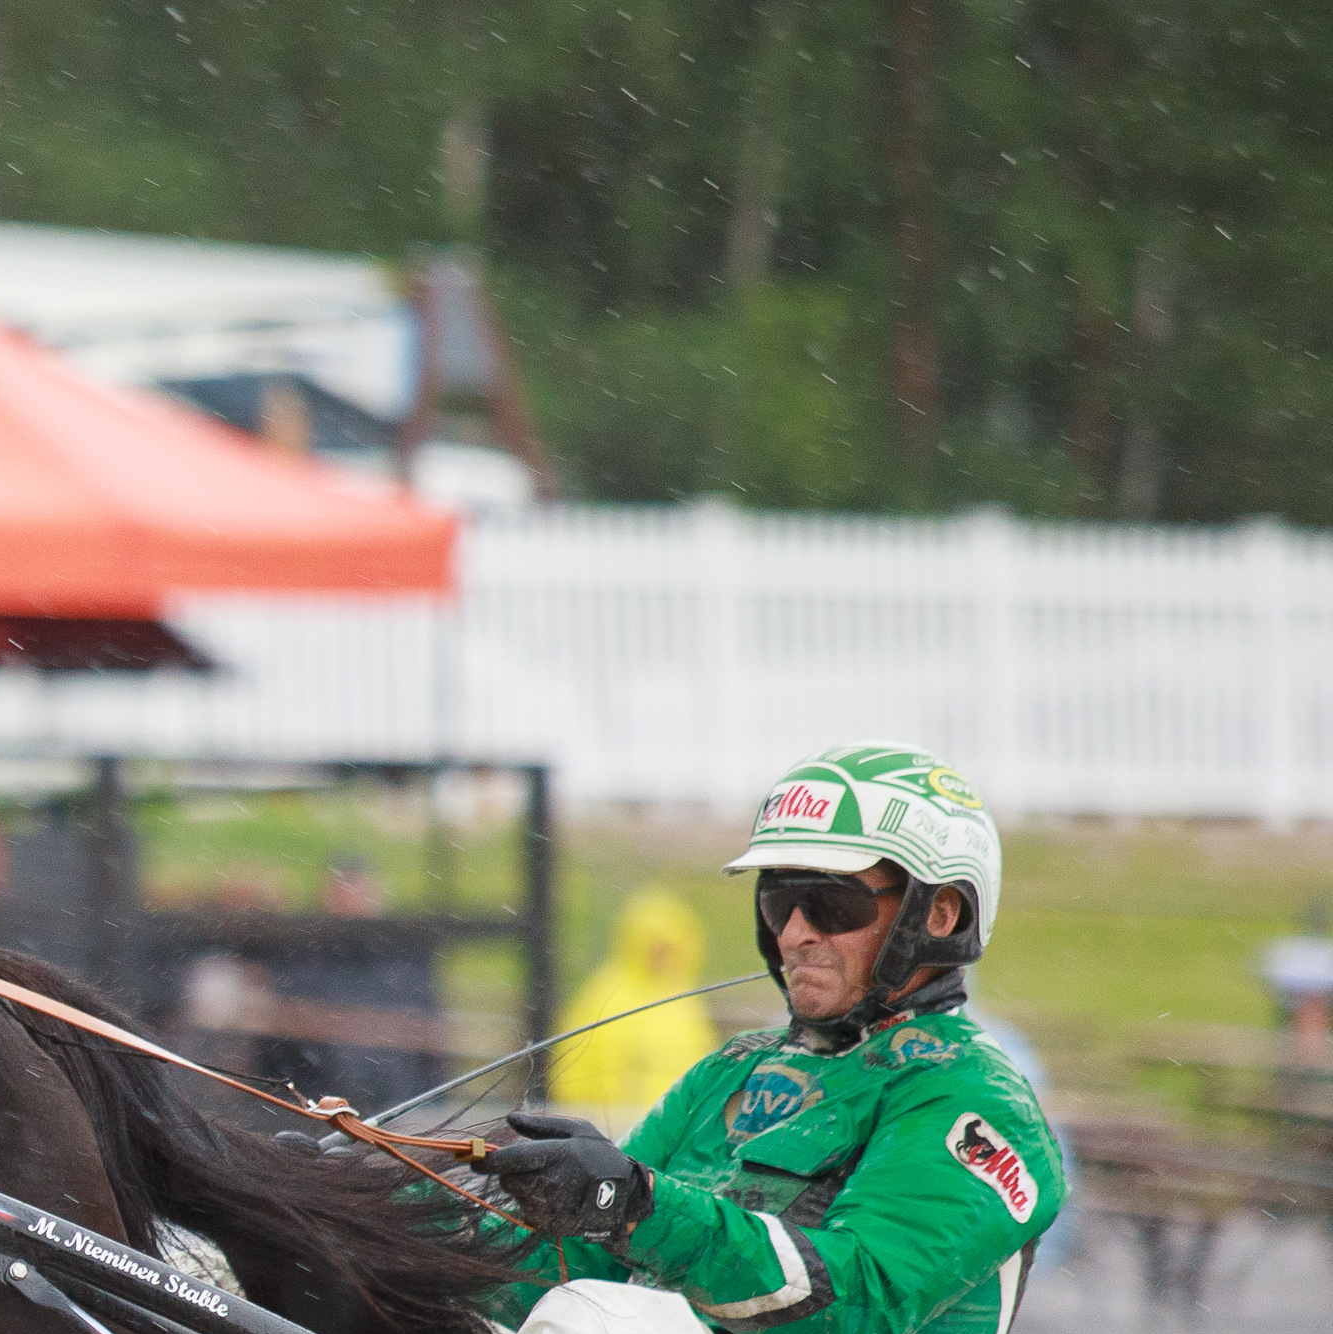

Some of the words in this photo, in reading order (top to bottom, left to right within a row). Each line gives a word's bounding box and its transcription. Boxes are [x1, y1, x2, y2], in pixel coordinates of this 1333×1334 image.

[967, 1142, 1029, 1212] Mira
[28, 1216, 62, 1243] M.
[63, 1233, 162, 1286] Nieminen
[163, 1272, 231, 1318] Stable
